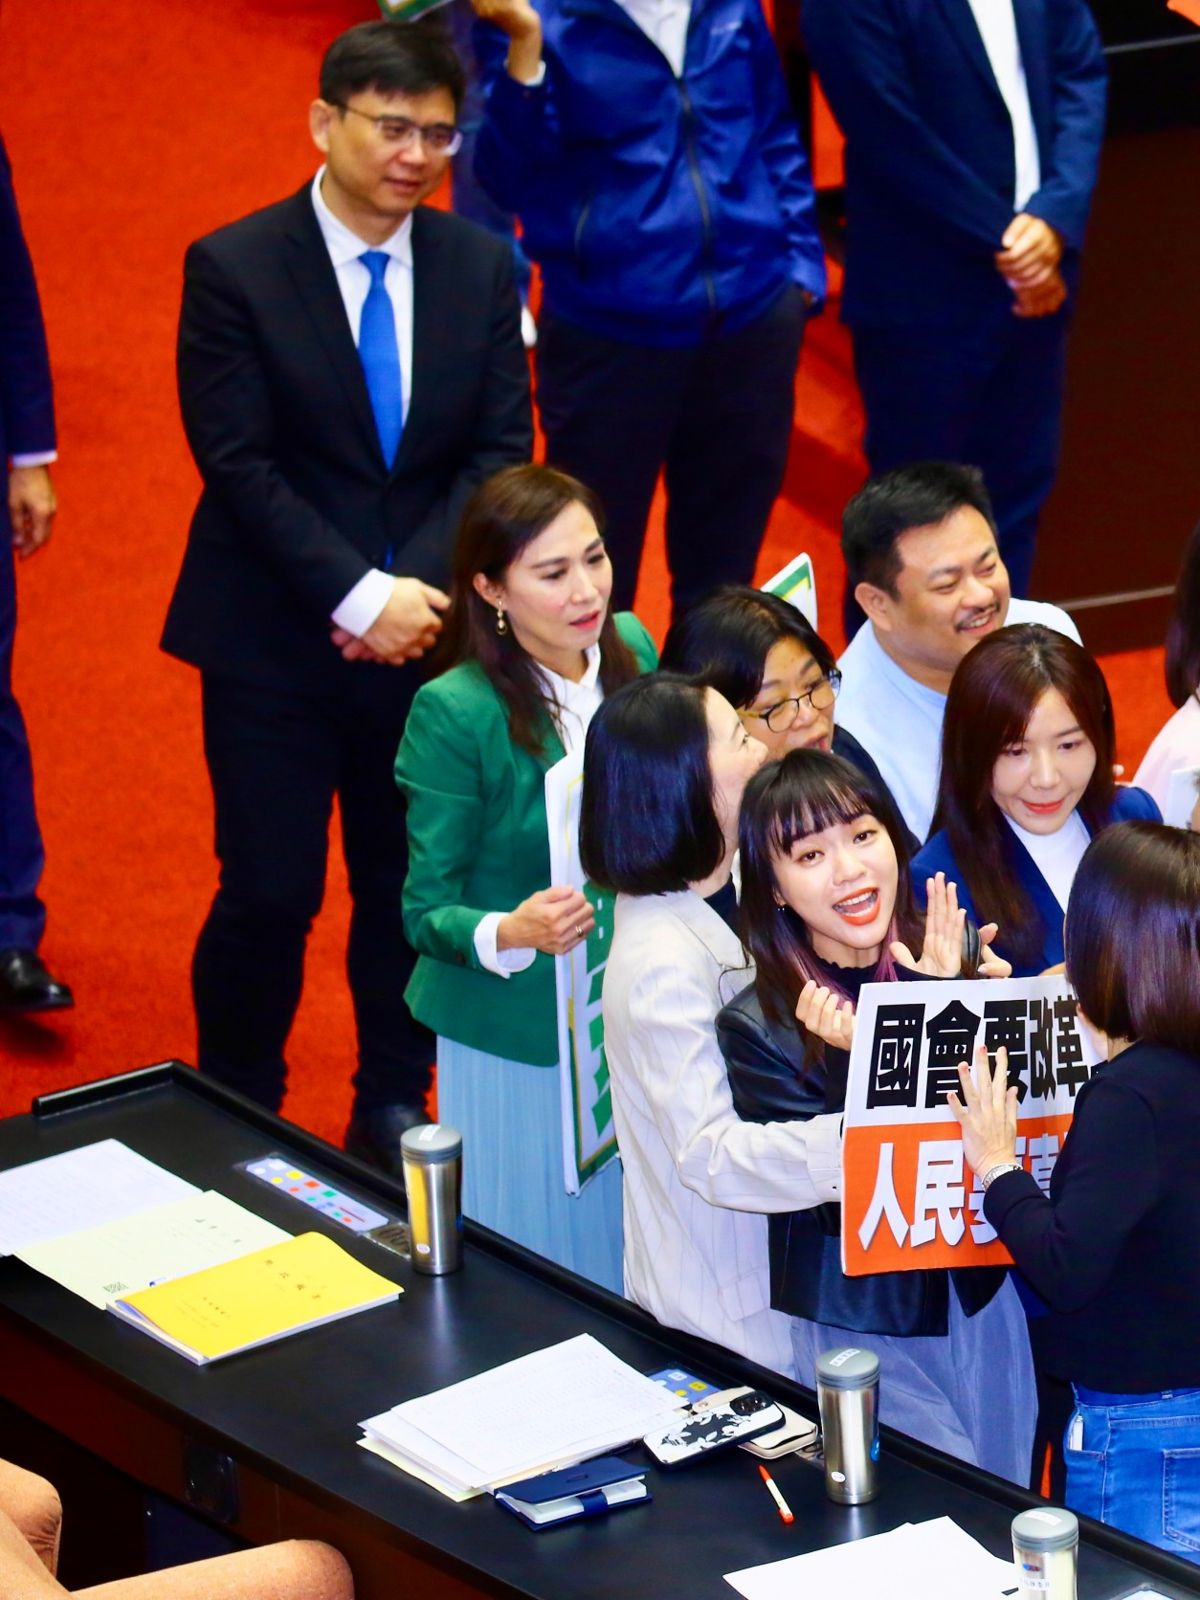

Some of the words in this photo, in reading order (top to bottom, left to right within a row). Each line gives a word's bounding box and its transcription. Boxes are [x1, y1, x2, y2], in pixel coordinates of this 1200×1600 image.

[866, 994, 1090, 1111] 國會要改革
